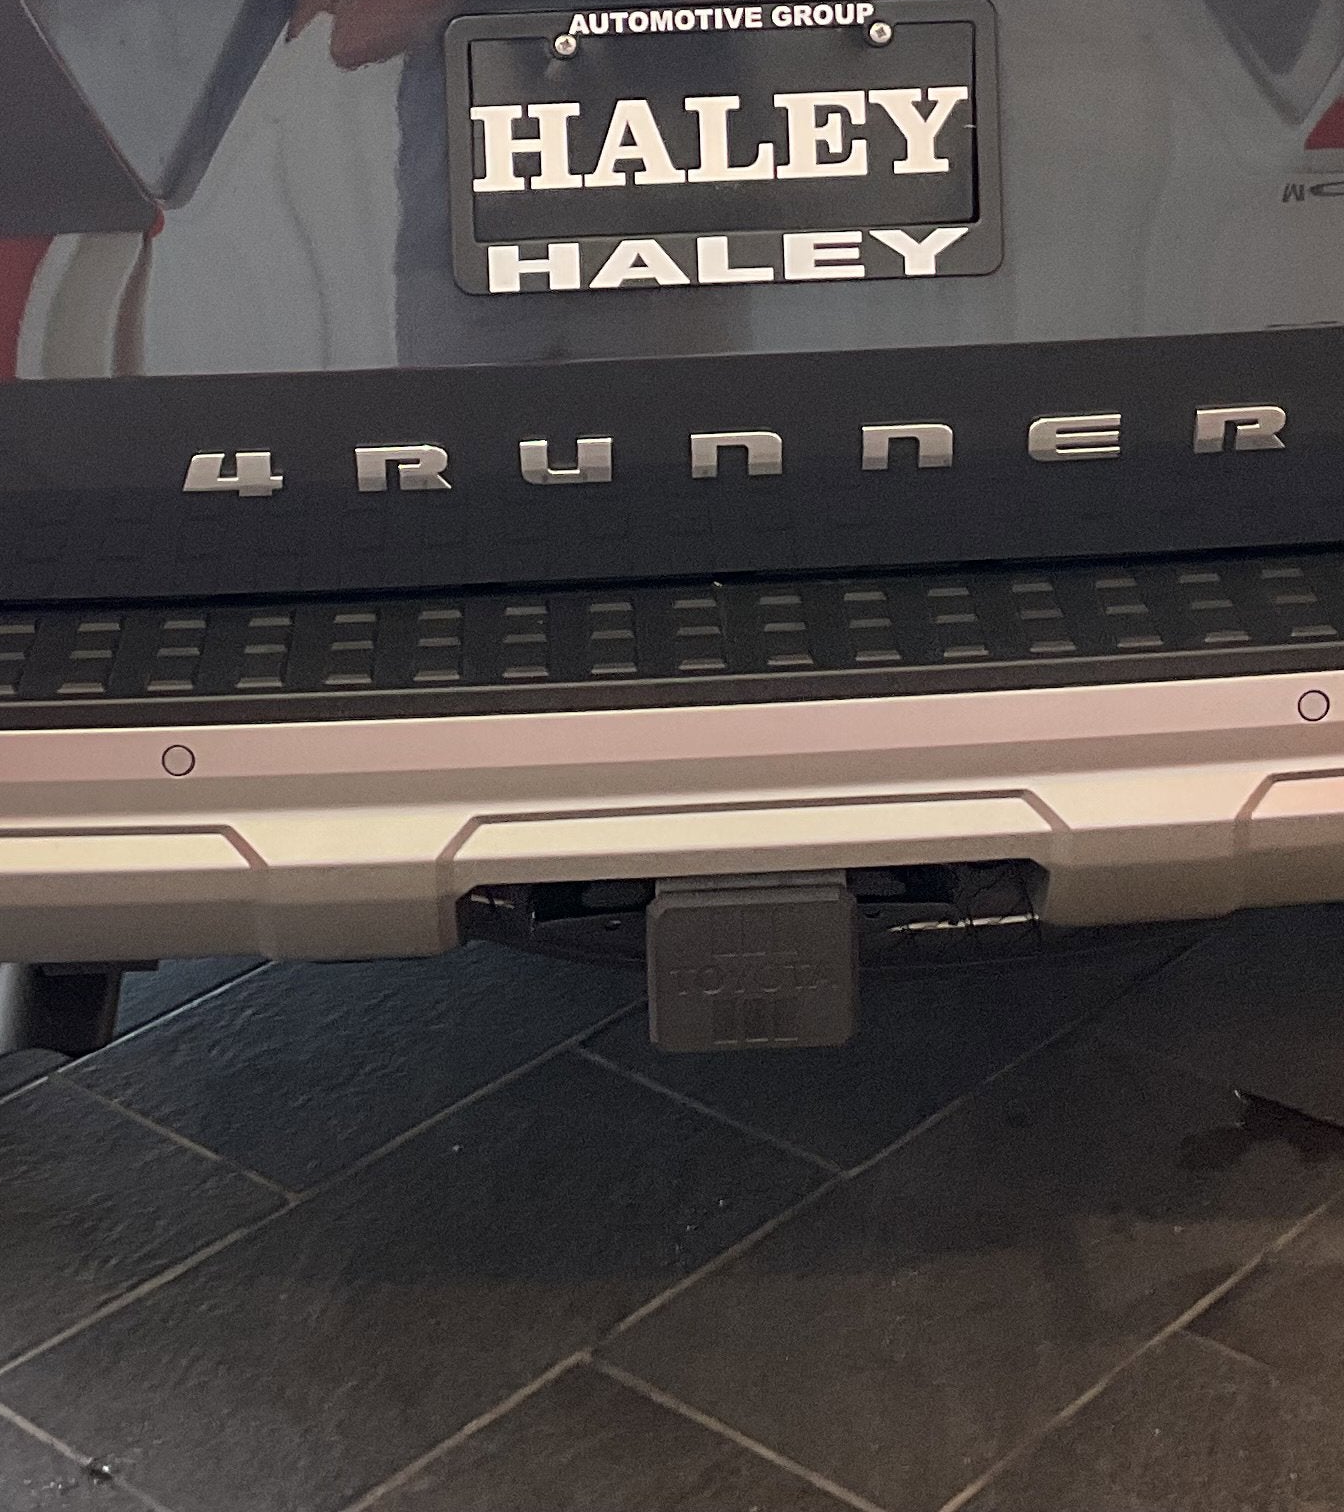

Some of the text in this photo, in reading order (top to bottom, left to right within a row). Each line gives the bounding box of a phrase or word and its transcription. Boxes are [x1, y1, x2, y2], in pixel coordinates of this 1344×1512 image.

[568, 2, 876, 37] AUTOMOTIVE GROUP
[469, 85, 969, 193] HALEY
[487, 226, 969, 293] HALEY
[182, 404, 1287, 497] 4RUNNER
